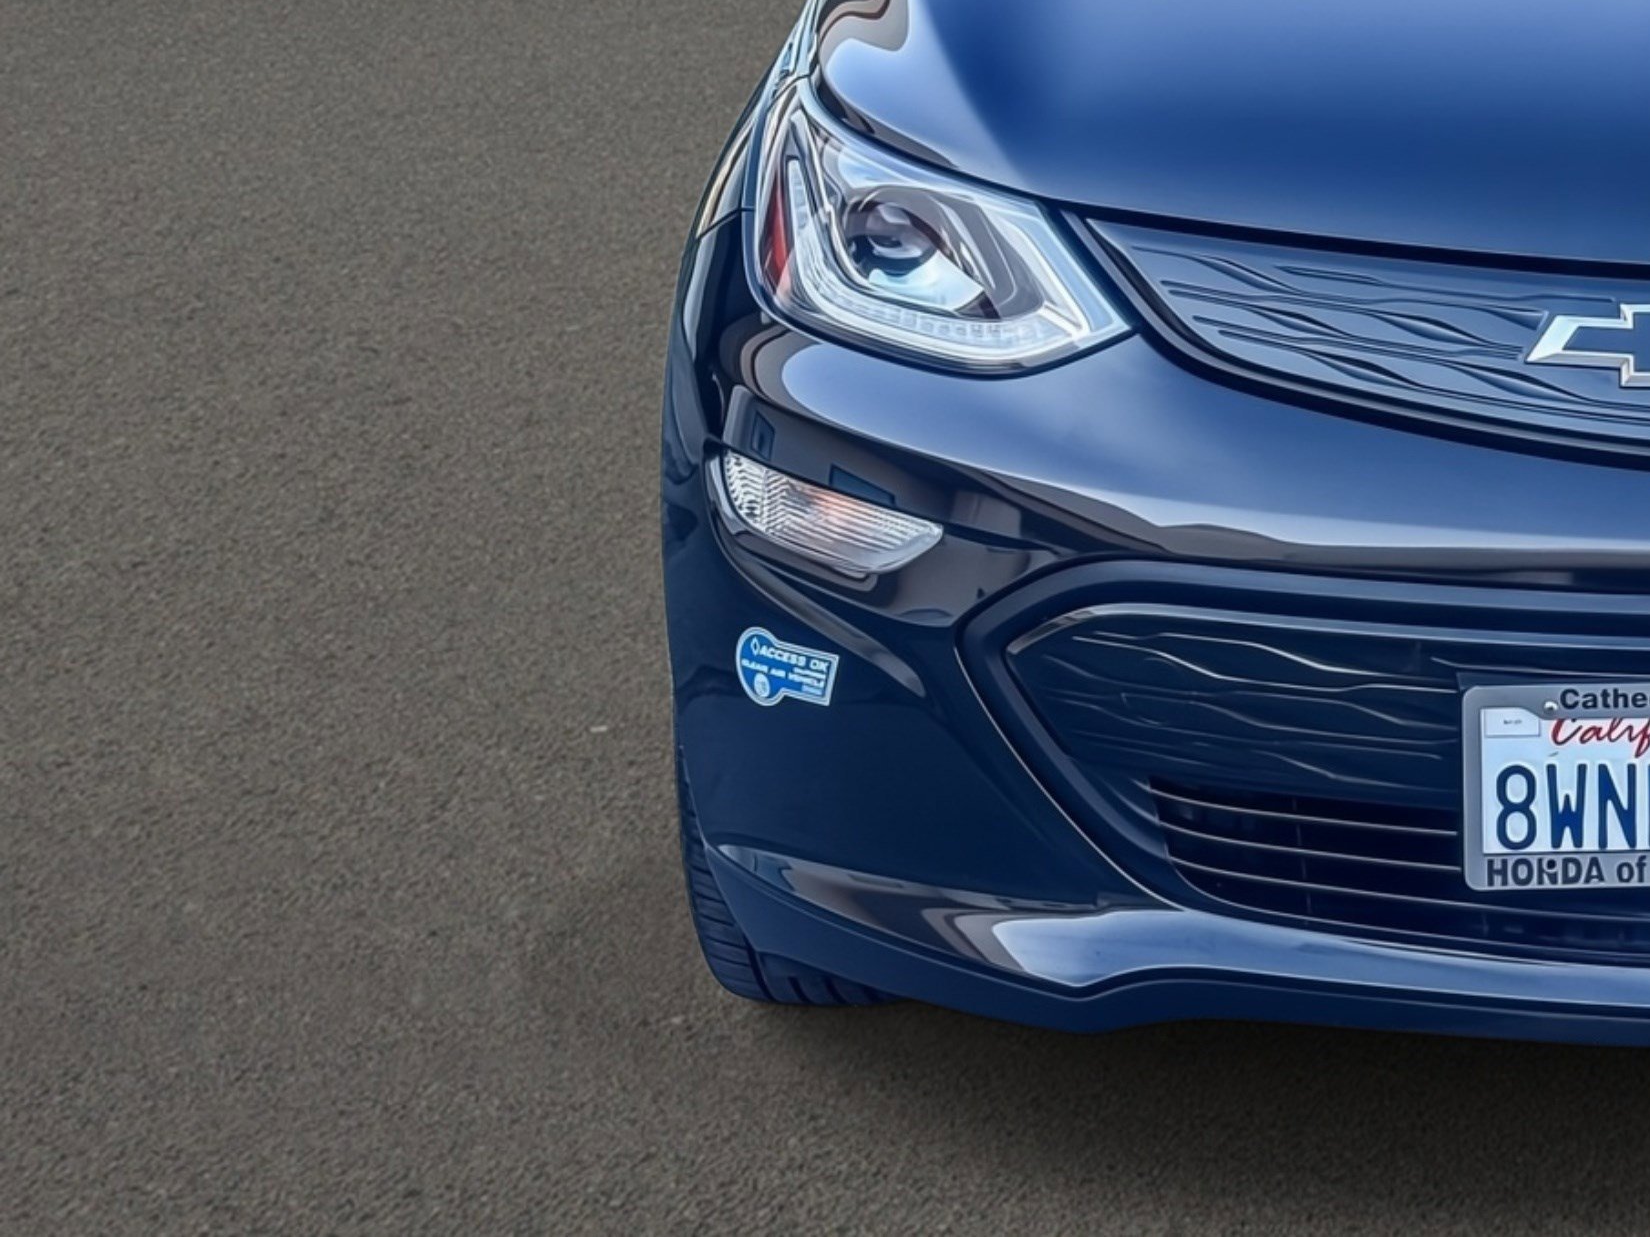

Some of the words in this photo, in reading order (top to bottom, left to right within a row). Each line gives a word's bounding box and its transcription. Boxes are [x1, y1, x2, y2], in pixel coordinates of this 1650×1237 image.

[760, 645, 806, 667] ACCESS
[809, 659, 829, 673] OK
[1487, 856, 1605, 887] HONDA
[1616, 855, 1646, 883] of
